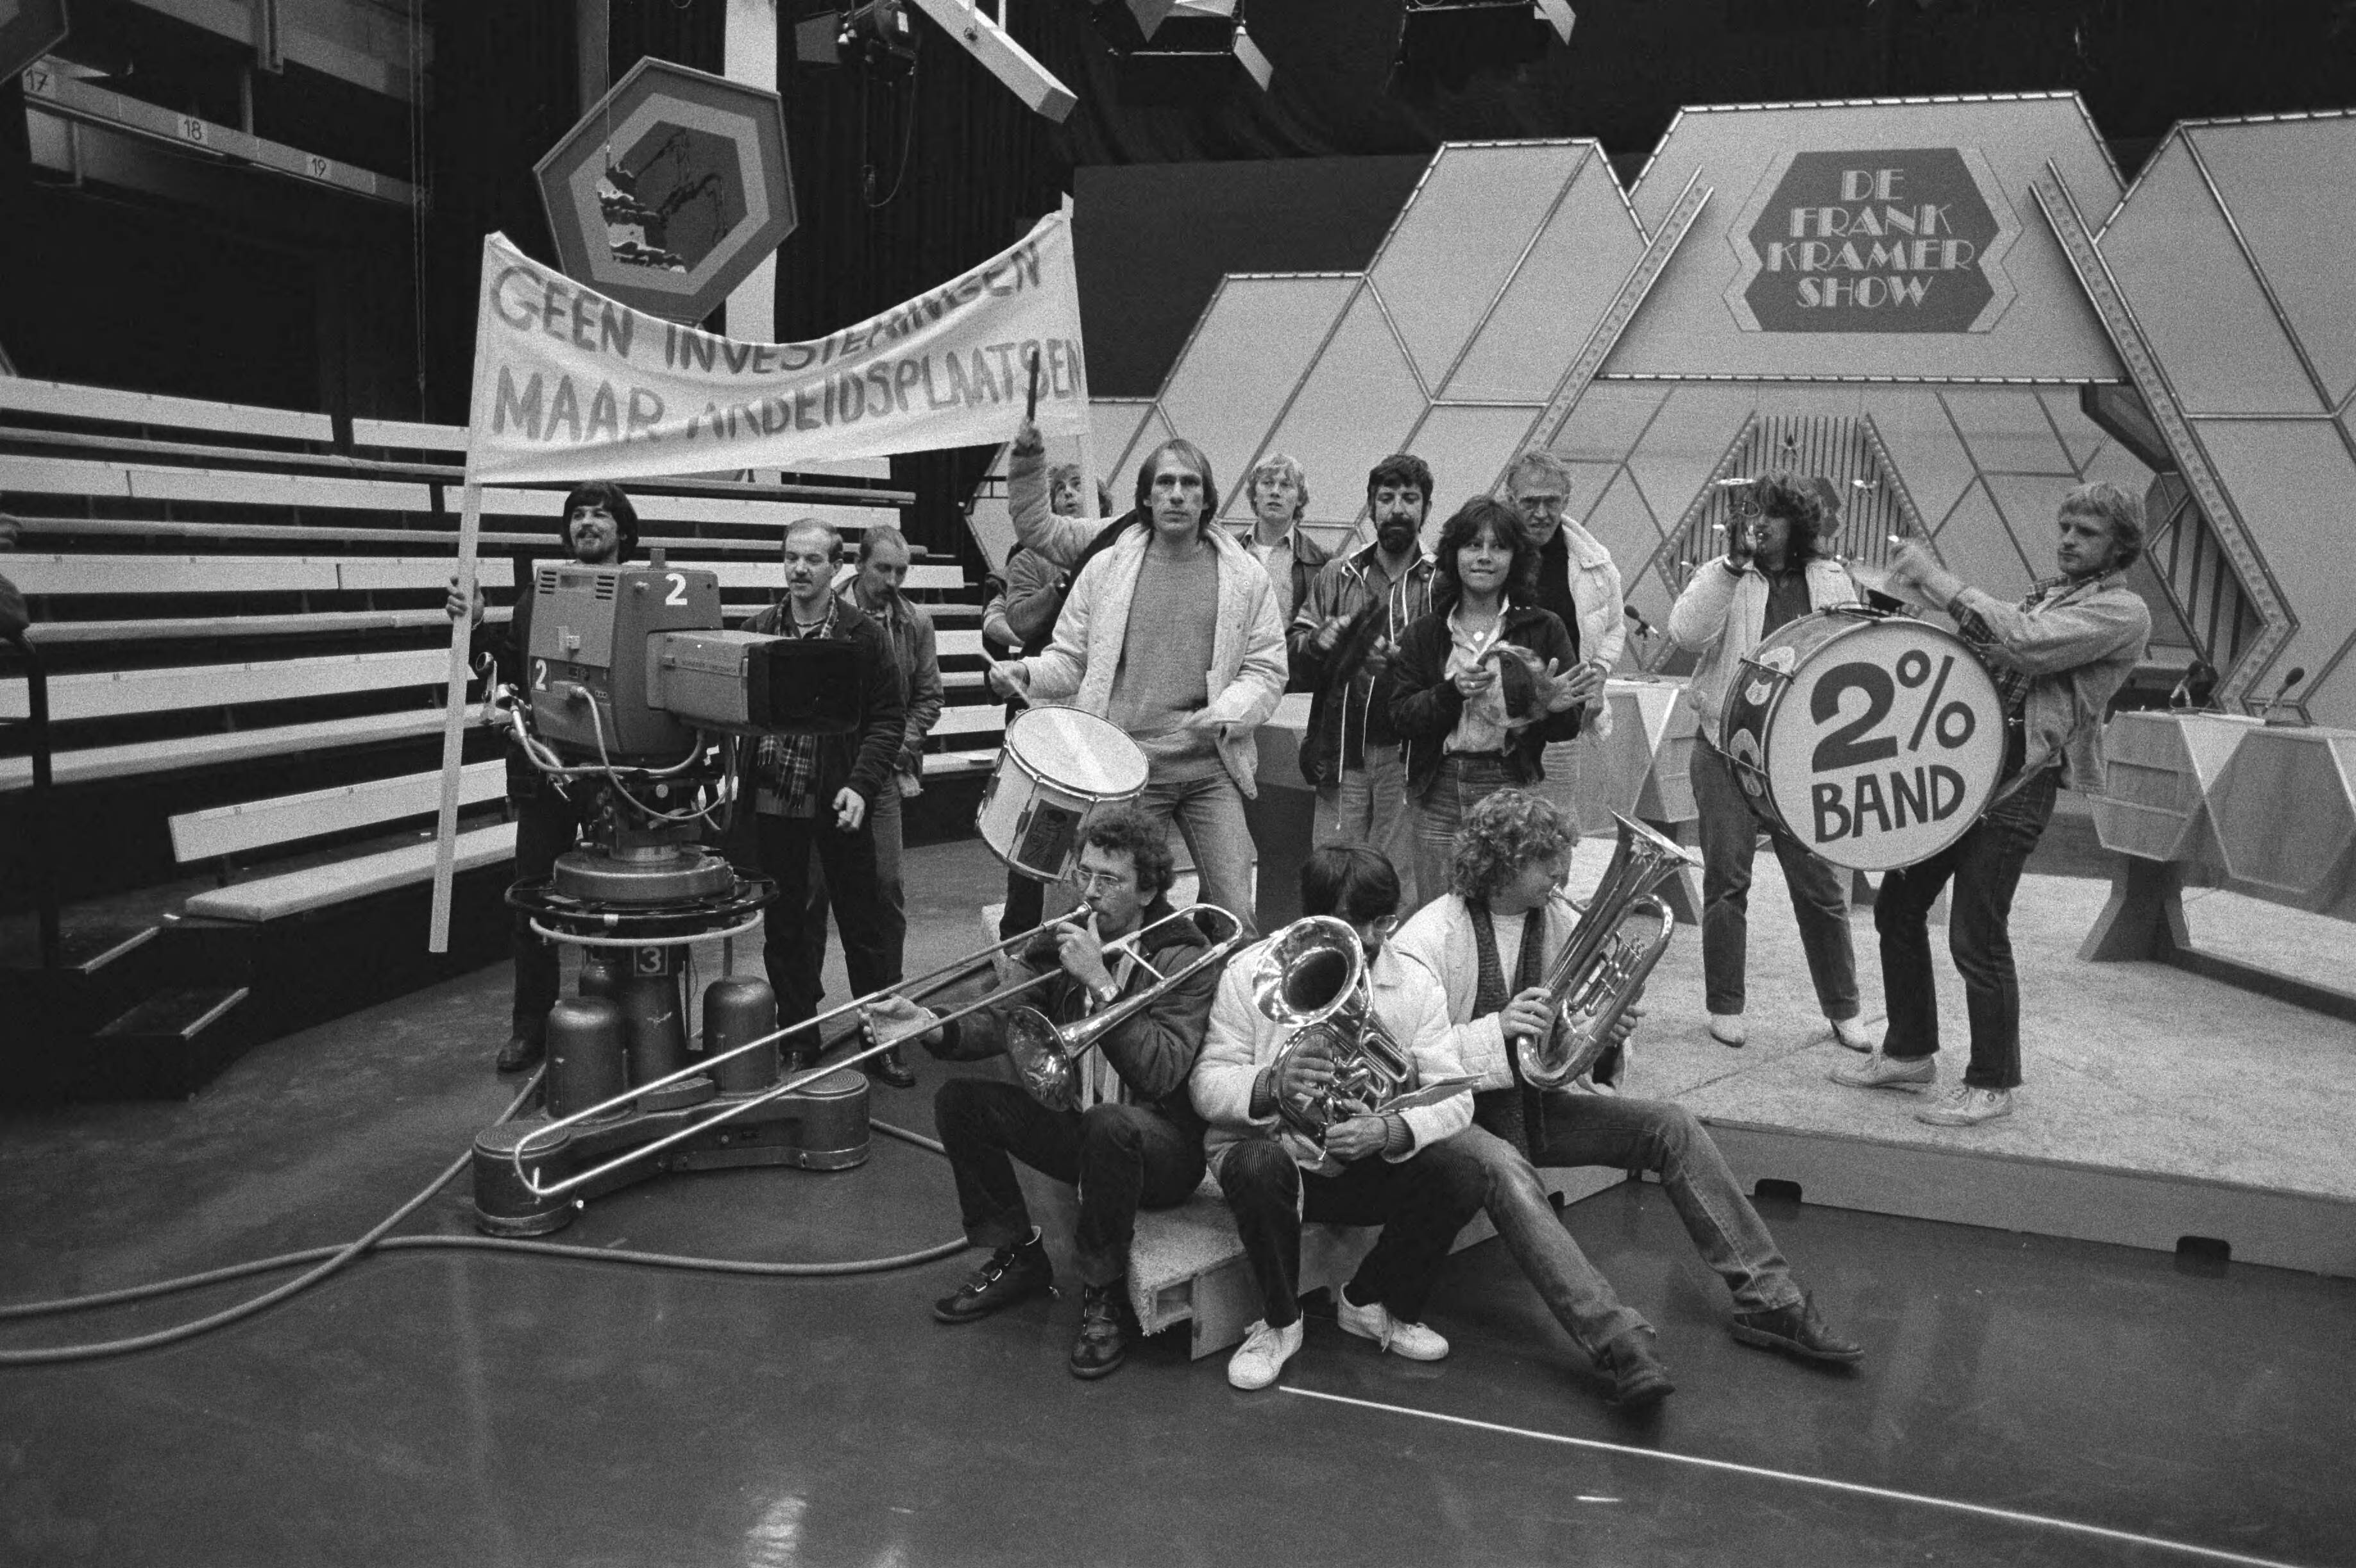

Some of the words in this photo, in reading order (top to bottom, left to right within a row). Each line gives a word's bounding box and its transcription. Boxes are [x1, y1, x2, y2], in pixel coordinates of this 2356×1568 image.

[26, 67, 47, 92] 17
[183, 118, 201, 140] 18
[312, 157, 327, 178] 19
[1841, 168, 1904, 201] DE
[1790, 203, 1953, 237] FRANK
[1767, 239, 1975, 271] KRAMER
[1797, 276, 1935, 308] SHOW
[490, 266, 634, 359] GEEN
[665, 573, 688, 606] 2
[535, 658, 547, 691] 2
[1809, 649, 1976, 773] 2%
[1811, 764, 1966, 845] BAND
[639, 946, 662, 973] 3
